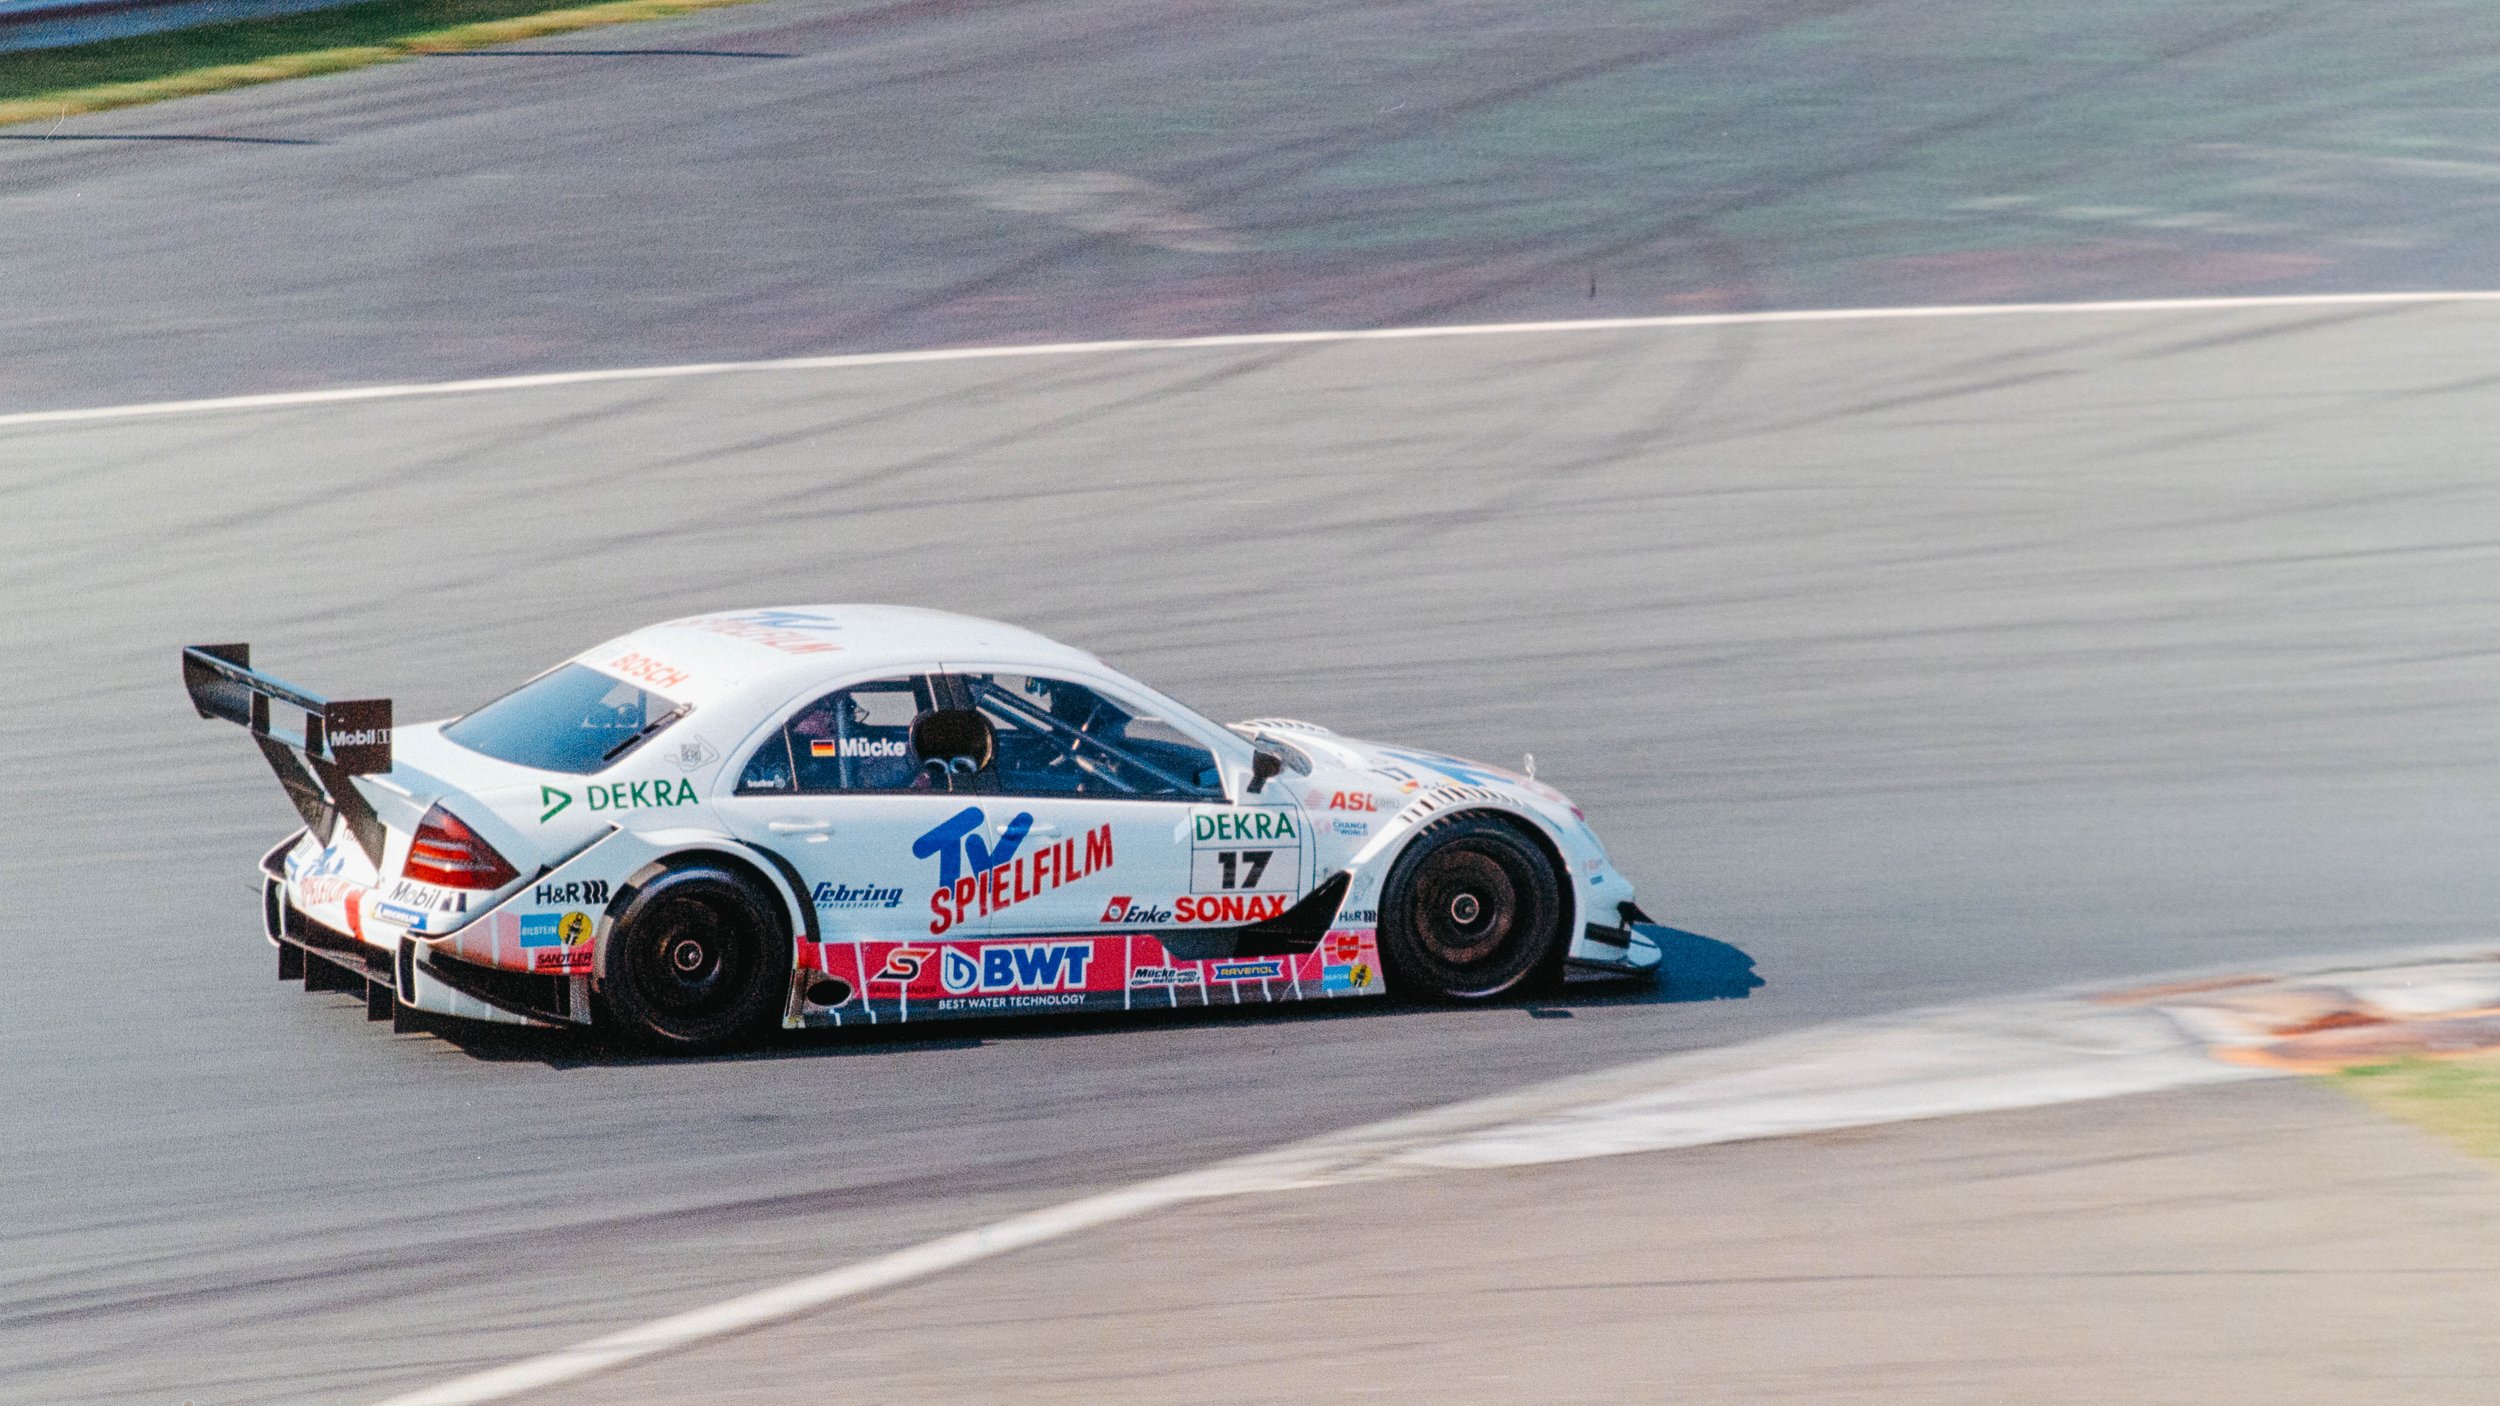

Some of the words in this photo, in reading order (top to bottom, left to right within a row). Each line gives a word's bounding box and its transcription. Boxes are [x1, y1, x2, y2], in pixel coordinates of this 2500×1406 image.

[609, 652, 690, 689] BOSCH
[330, 728, 376, 747] Mobil
[838, 737, 906, 758] Mücke
[586, 777, 700, 811] DEKRA
[1328, 790, 1377, 812] ASL
[1195, 811, 1296, 841] DEKRA
[911, 806, 1034, 901] TV
[929, 822, 1115, 935] SPIELFILM
[1218, 850, 1274, 890] 17
[388, 880, 442, 911] Mobil
[536, 881, 581, 905] H&R
[1122, 905, 1171, 924] Enke
[1174, 894, 1288, 924] SONAX
[1338, 911, 1362, 922] H&R
[521, 925, 558, 937] BILSTEIN
[980, 943, 1093, 990] BWT
[1220, 965, 1275, 977] RAVENOL
[939, 998, 966, 1010] BEST
[968, 996, 1007, 1009] WATER
[1009, 993, 1086, 1006] TECHNOLOGY
